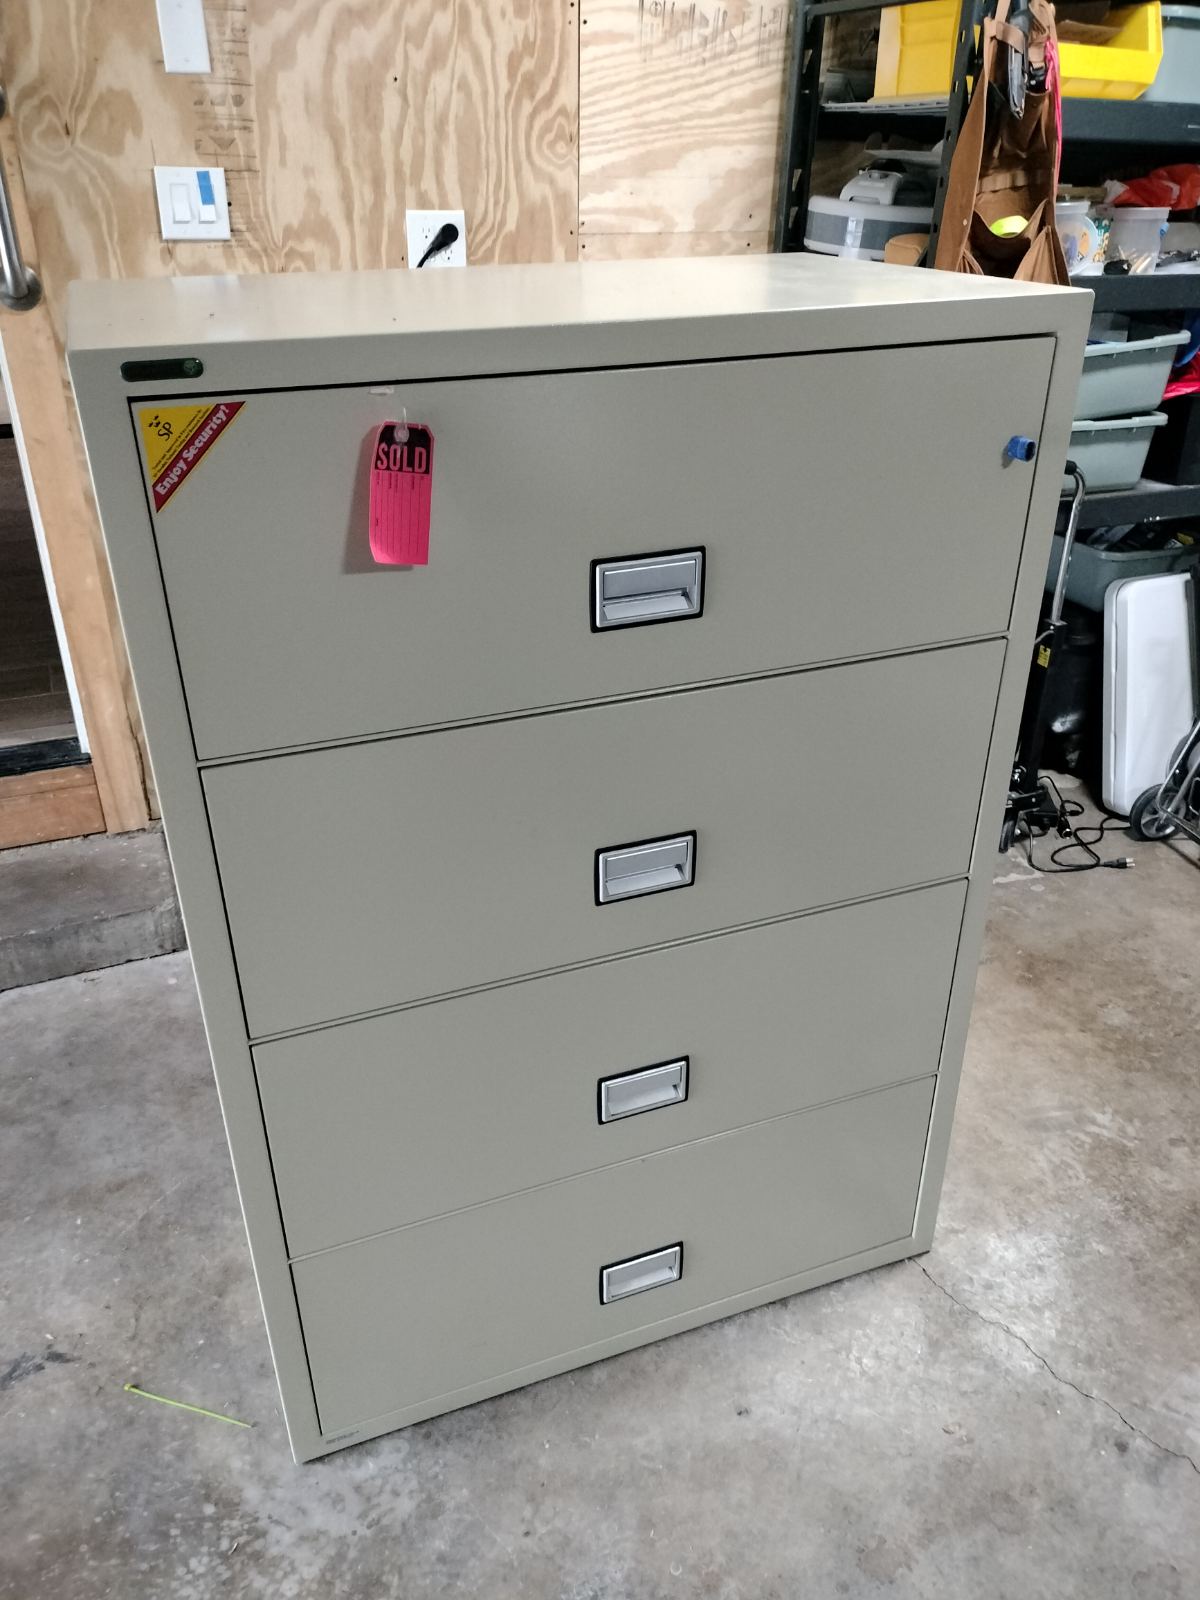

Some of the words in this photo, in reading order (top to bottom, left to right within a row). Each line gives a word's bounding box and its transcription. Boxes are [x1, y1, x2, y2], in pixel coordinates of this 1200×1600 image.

[157, 421, 173, 441] SP
[155, 459, 187, 495] Enjoy
[182, 404, 229, 461] Security!
[376, 442, 427, 473] SOLD
